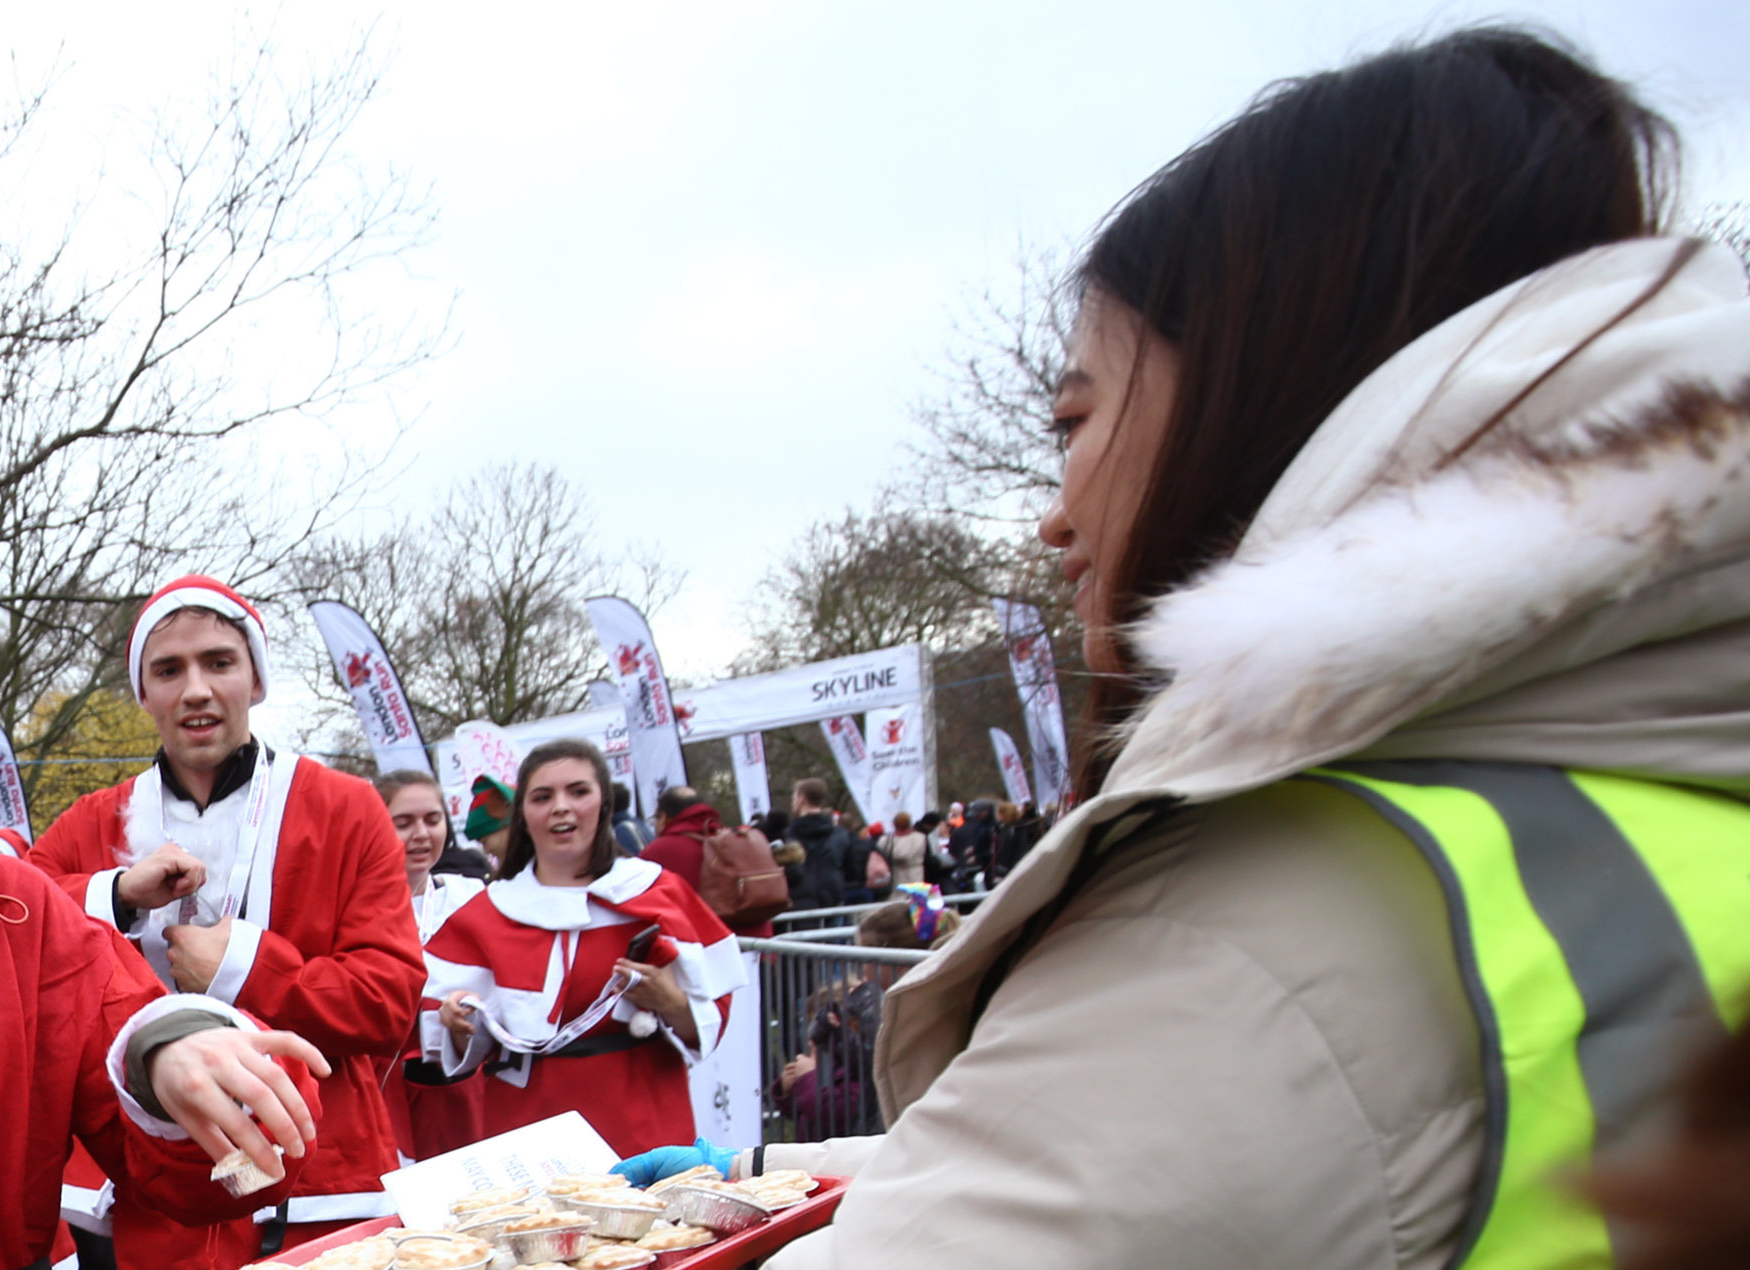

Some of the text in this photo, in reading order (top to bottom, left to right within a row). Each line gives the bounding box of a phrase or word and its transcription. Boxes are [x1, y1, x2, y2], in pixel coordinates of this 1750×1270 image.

[369, 685, 399, 744] London
[374, 661, 412, 738] Santa Run
[644, 653, 669, 725] Santa Run
[812, 666, 897, 702] SKYLINE
[0, 780, 15, 828] London
[4, 763, 25, 826] Santa Run
